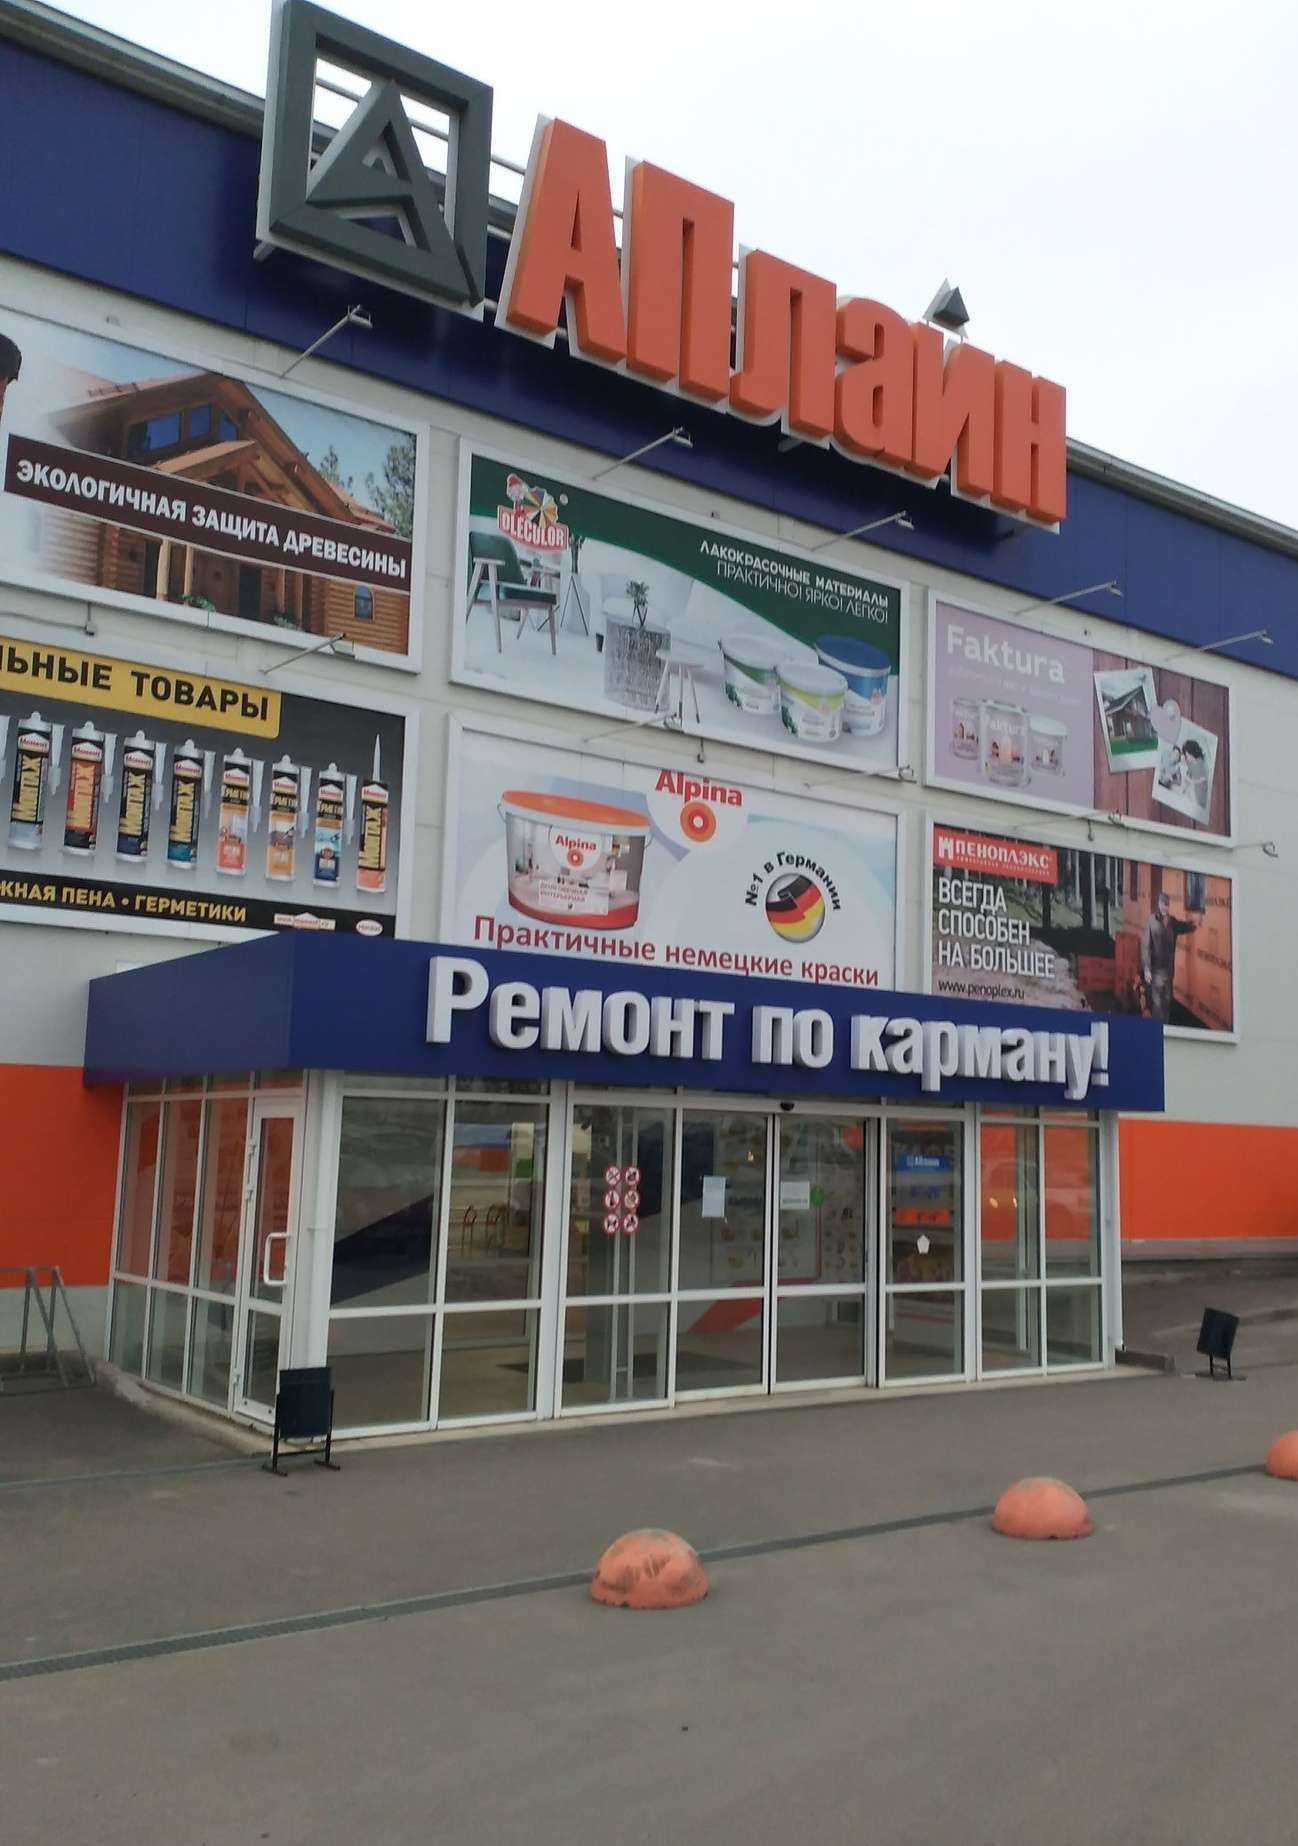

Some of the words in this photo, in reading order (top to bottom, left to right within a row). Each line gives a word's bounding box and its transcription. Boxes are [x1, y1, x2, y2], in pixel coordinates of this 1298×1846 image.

[16, 459, 186, 522] ЭКОЛОГИЧНАЯ
[192, 505, 280, 546] ЗАЩИТА
[283, 532, 406, 578] ДРЕВЕСИНЫ
[700, 540, 811, 586] ЛАКОКРАСОЧНЫЕ
[816, 575, 889, 608] МАТЕРИАЛЫ
[717, 560, 802, 600] ПРАКТИЧНО!
[805, 587, 843, 612] ЯРКО!
[845, 603, 888, 624] ЛЕГКО!
[947, 624, 1065, 684] Faktura
[0, 645, 112, 691] ЬНЫЕ
[131, 670, 268, 721] ТОВАРЫ
[655, 768, 743, 807] Alpina
[555, 835, 597, 850] Alpina
[955, 839, 1049, 869] ПЕНОПЛЭКС
[62, 887, 116, 908] ПЕНА
[135, 895, 246, 922] ГЕРМЕТИКИ
[745, 872, 763, 906] №1
[763, 861, 775, 874] в
[776, 851, 841, 911] Германии
[938, 877, 1007, 915] ВСЕГДА
[474, 915, 655, 961] Практичные
[665, 947, 793, 979] немецкие
[802, 961, 879, 986] краски
[938, 908, 1031, 946] СПОСОБЕН
[938, 940, 964, 967] НА
[970, 944, 1056, 979] БОЛЬШЕЕ
[938, 980, 1025, 999] www.penoplex.ru
[426, 956, 735, 1061] Ремонт
[752, 1005, 834, 1069] по
[851, 1013, 1109, 1100] карману!
